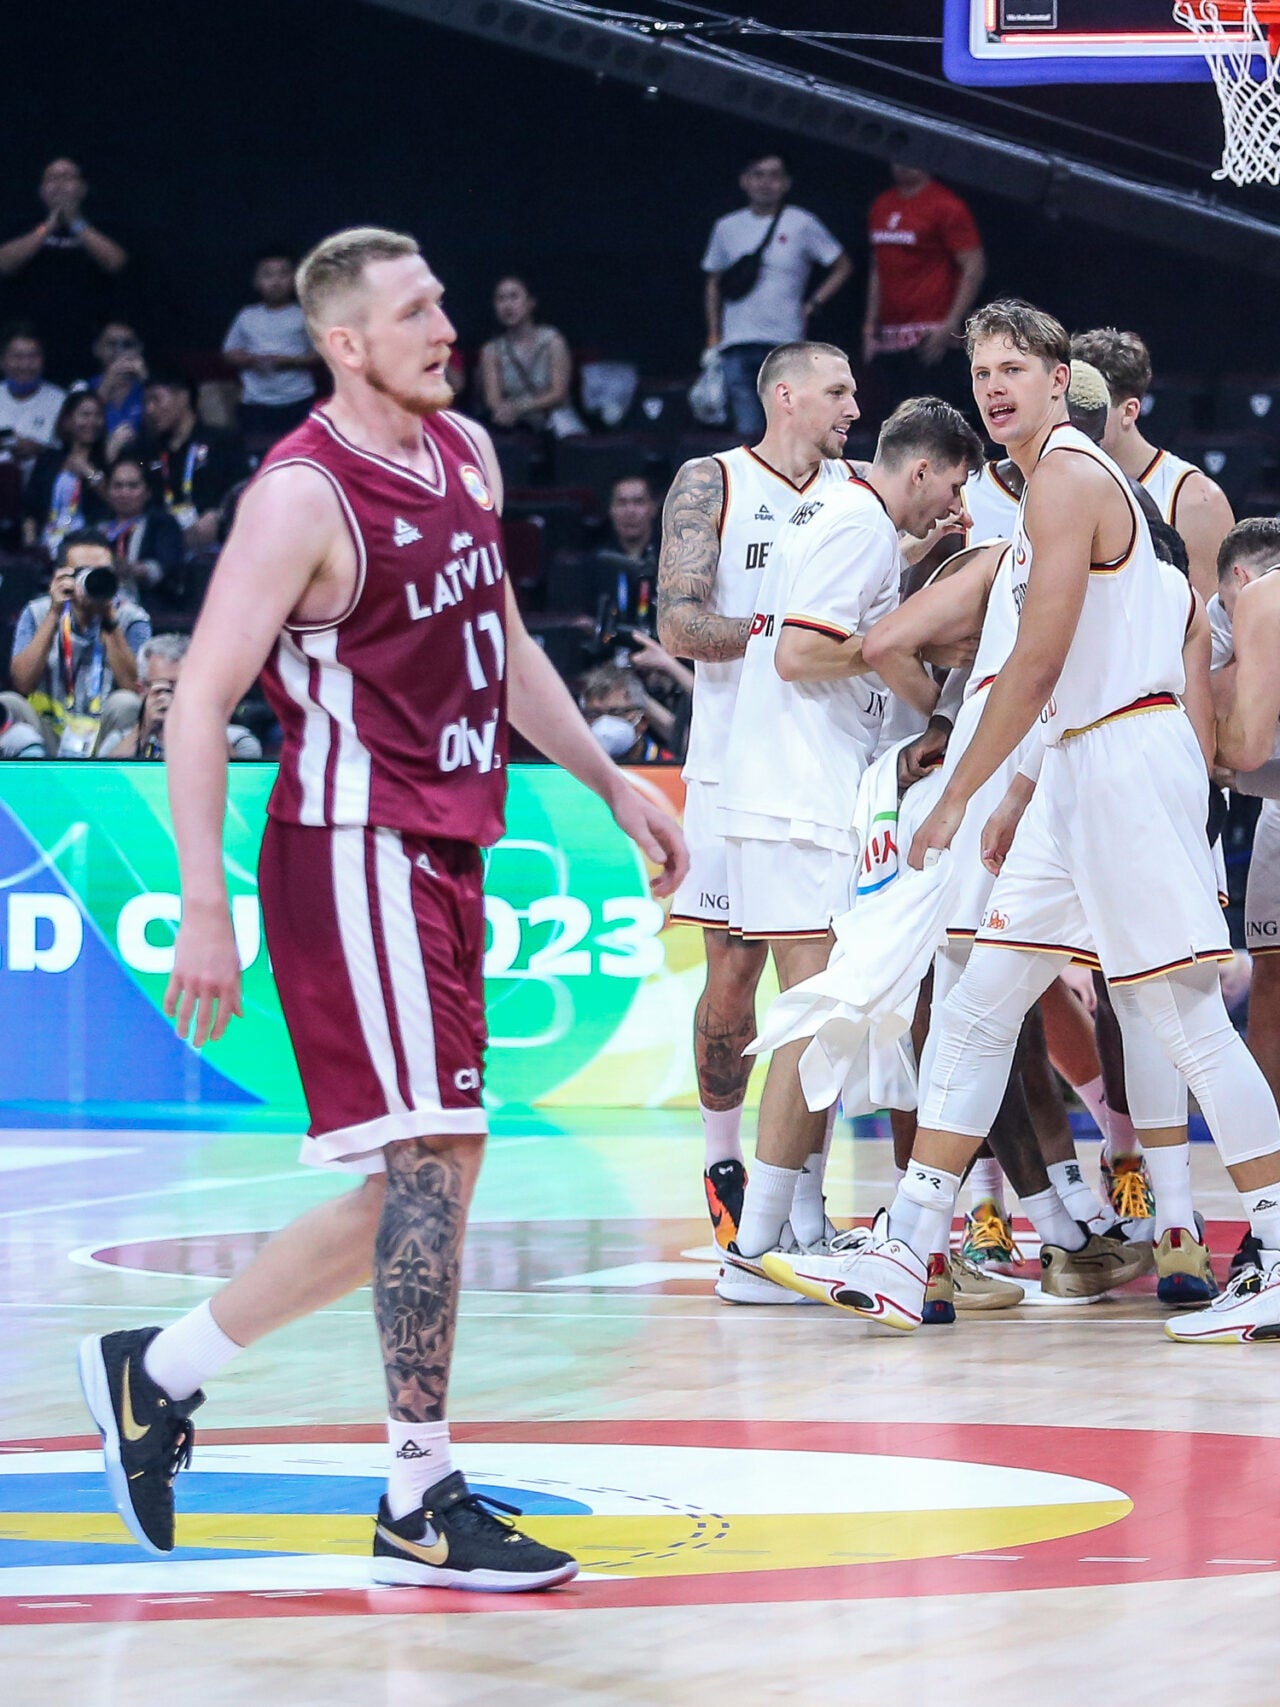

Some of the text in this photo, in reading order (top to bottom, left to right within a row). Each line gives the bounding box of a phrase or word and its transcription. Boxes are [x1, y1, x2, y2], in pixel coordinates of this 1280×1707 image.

[745, 541, 773, 570] DE
[699, 891, 730, 911] ING
[7, 892, 84, 974] D
[482, 893, 666, 979] 023
[1246, 921, 1278, 937] ING
